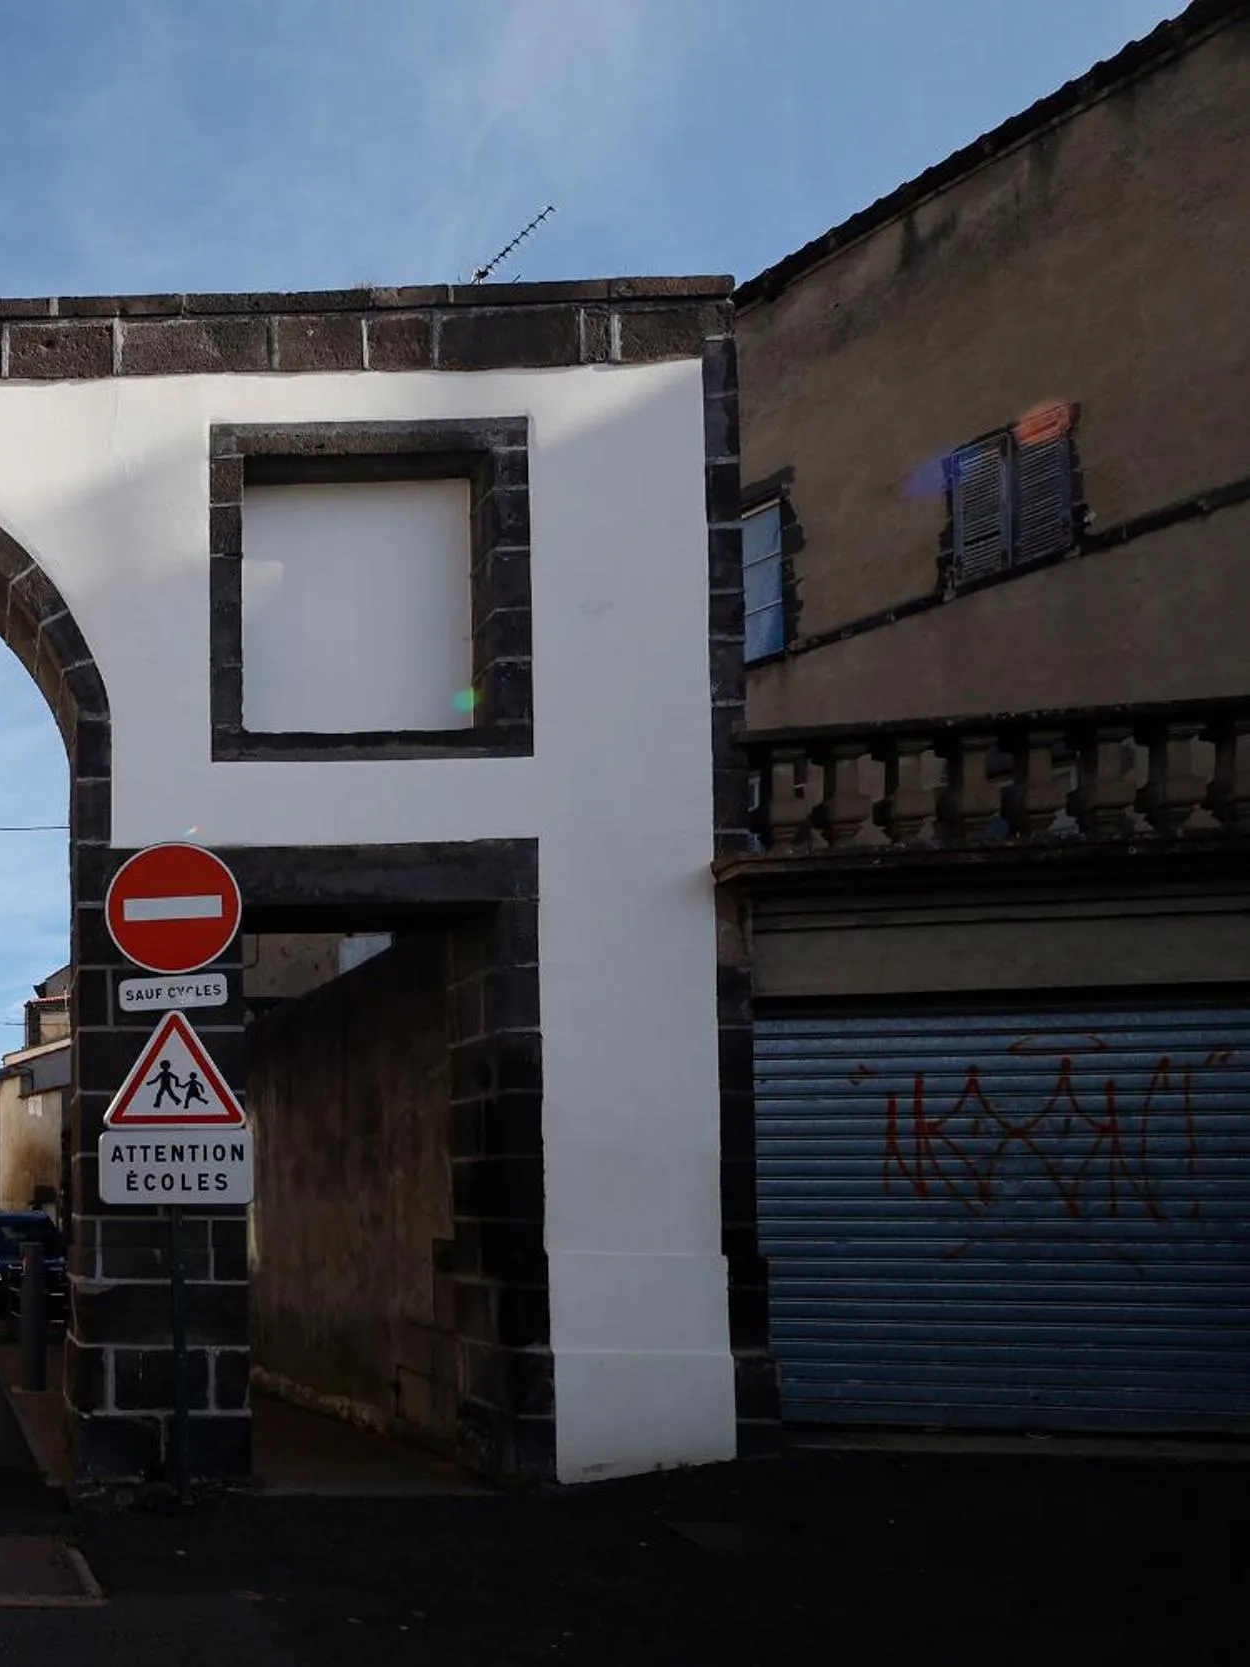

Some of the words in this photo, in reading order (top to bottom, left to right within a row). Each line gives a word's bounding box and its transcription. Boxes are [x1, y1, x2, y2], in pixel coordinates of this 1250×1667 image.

[126, 988, 163, 1001] SAUF
[111, 1144, 245, 1163] ATTENTION
[126, 1170, 229, 1192] ÉCOLES
